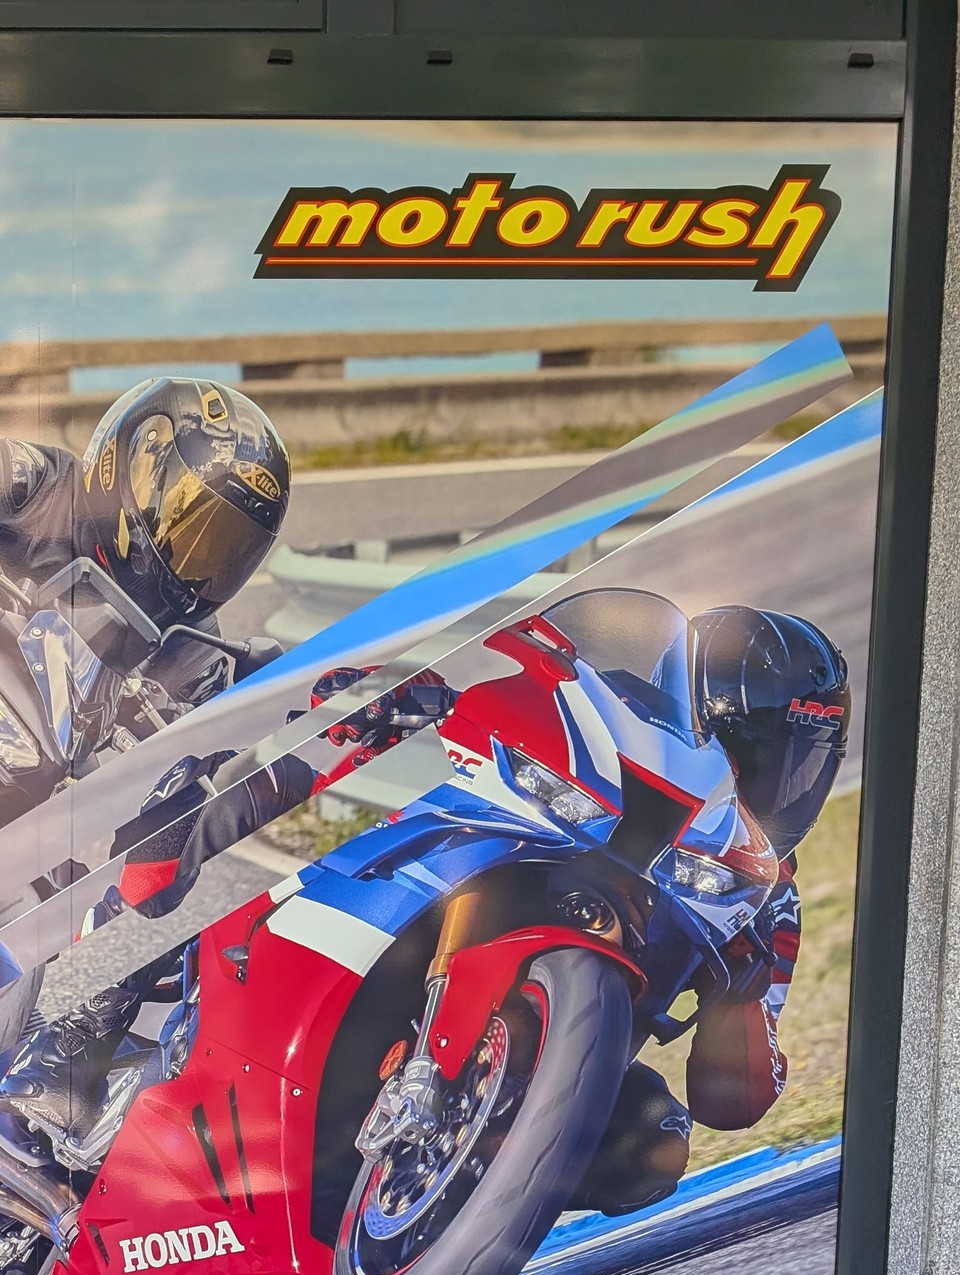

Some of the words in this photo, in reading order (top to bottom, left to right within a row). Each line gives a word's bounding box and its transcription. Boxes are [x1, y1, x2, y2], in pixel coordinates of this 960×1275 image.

[273, 180, 570, 248] moto
[576, 178, 826, 279] rush
[243, 462, 281, 499] X-lite
[649, 716, 688, 742] HONDA
[786, 698, 844, 730] HRC
[118, 1220, 246, 1274] HONDA
